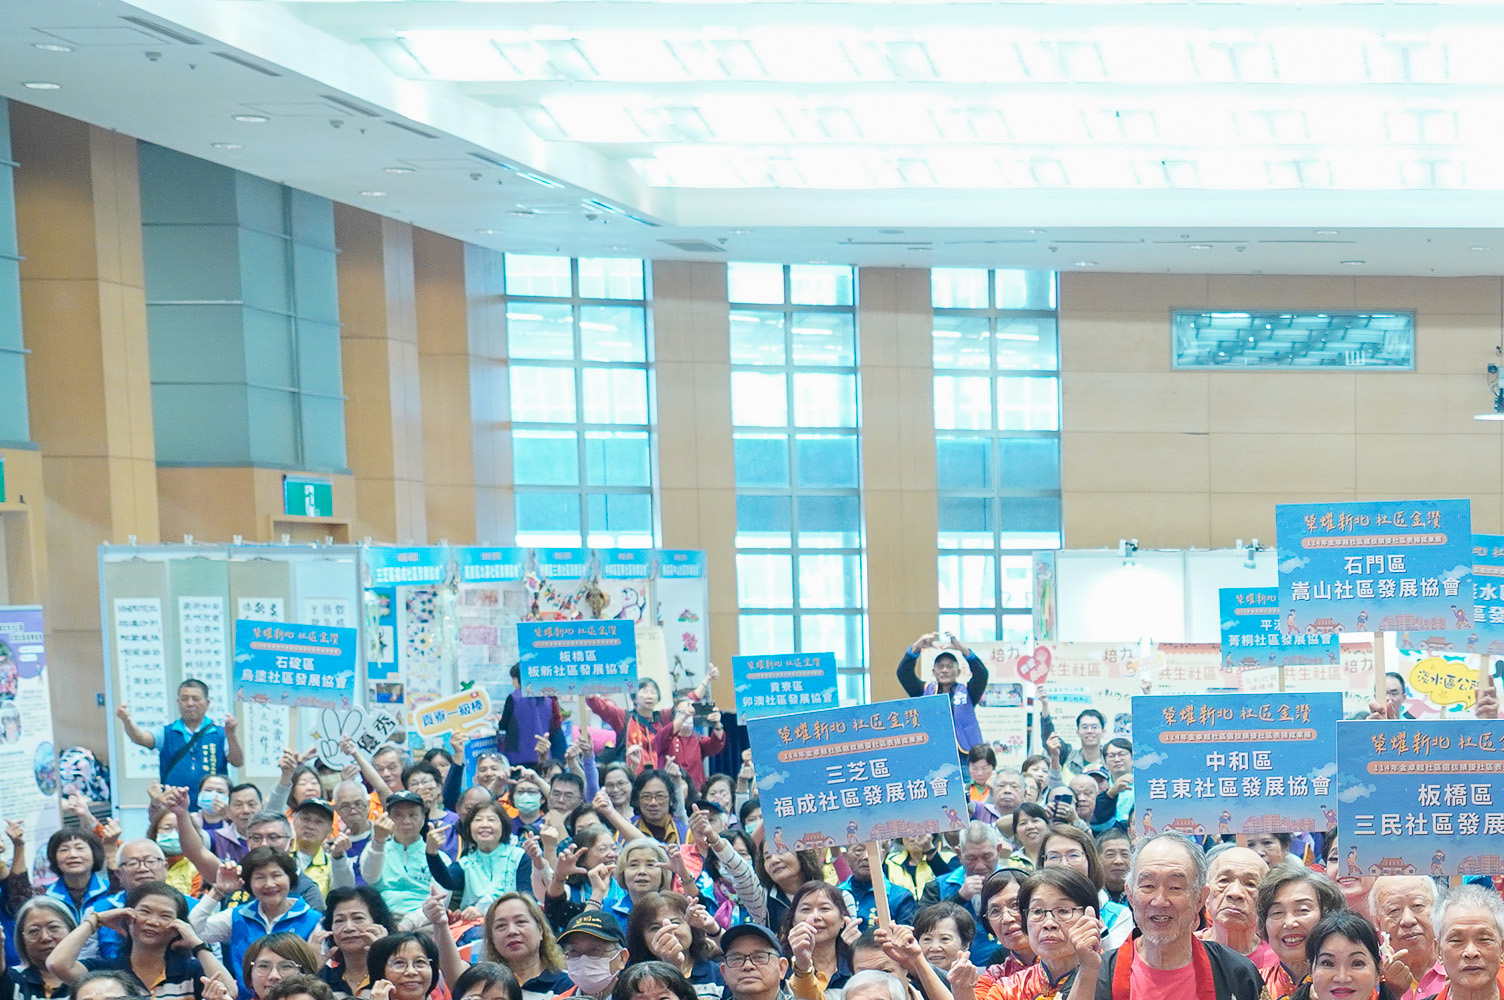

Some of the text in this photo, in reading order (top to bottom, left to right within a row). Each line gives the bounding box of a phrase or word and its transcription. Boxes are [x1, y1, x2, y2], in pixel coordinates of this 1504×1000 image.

[1343, 554, 1407, 575] 石門區
[1291, 577, 1461, 601] 嵩山社區發展協會
[275, 656, 314, 671] 石碇區
[559, 650, 597, 663] 板橋區
[528, 663, 630, 677] 板新社區發展協會
[421, 700, 484, 727] 貢寮一級棒
[1162, 704, 1312, 726] 榮耀新北 社區金讚
[778, 709, 921, 744] 榮耀新北 社區金讚
[1371, 731, 1450, 756] 榮耀新北
[825, 758, 891, 785] 三芝區
[1206, 750, 1273, 772] 中和區
[773, 776, 950, 818] 福成社區發展協會
[1417, 783, 1494, 807] 板橋區
